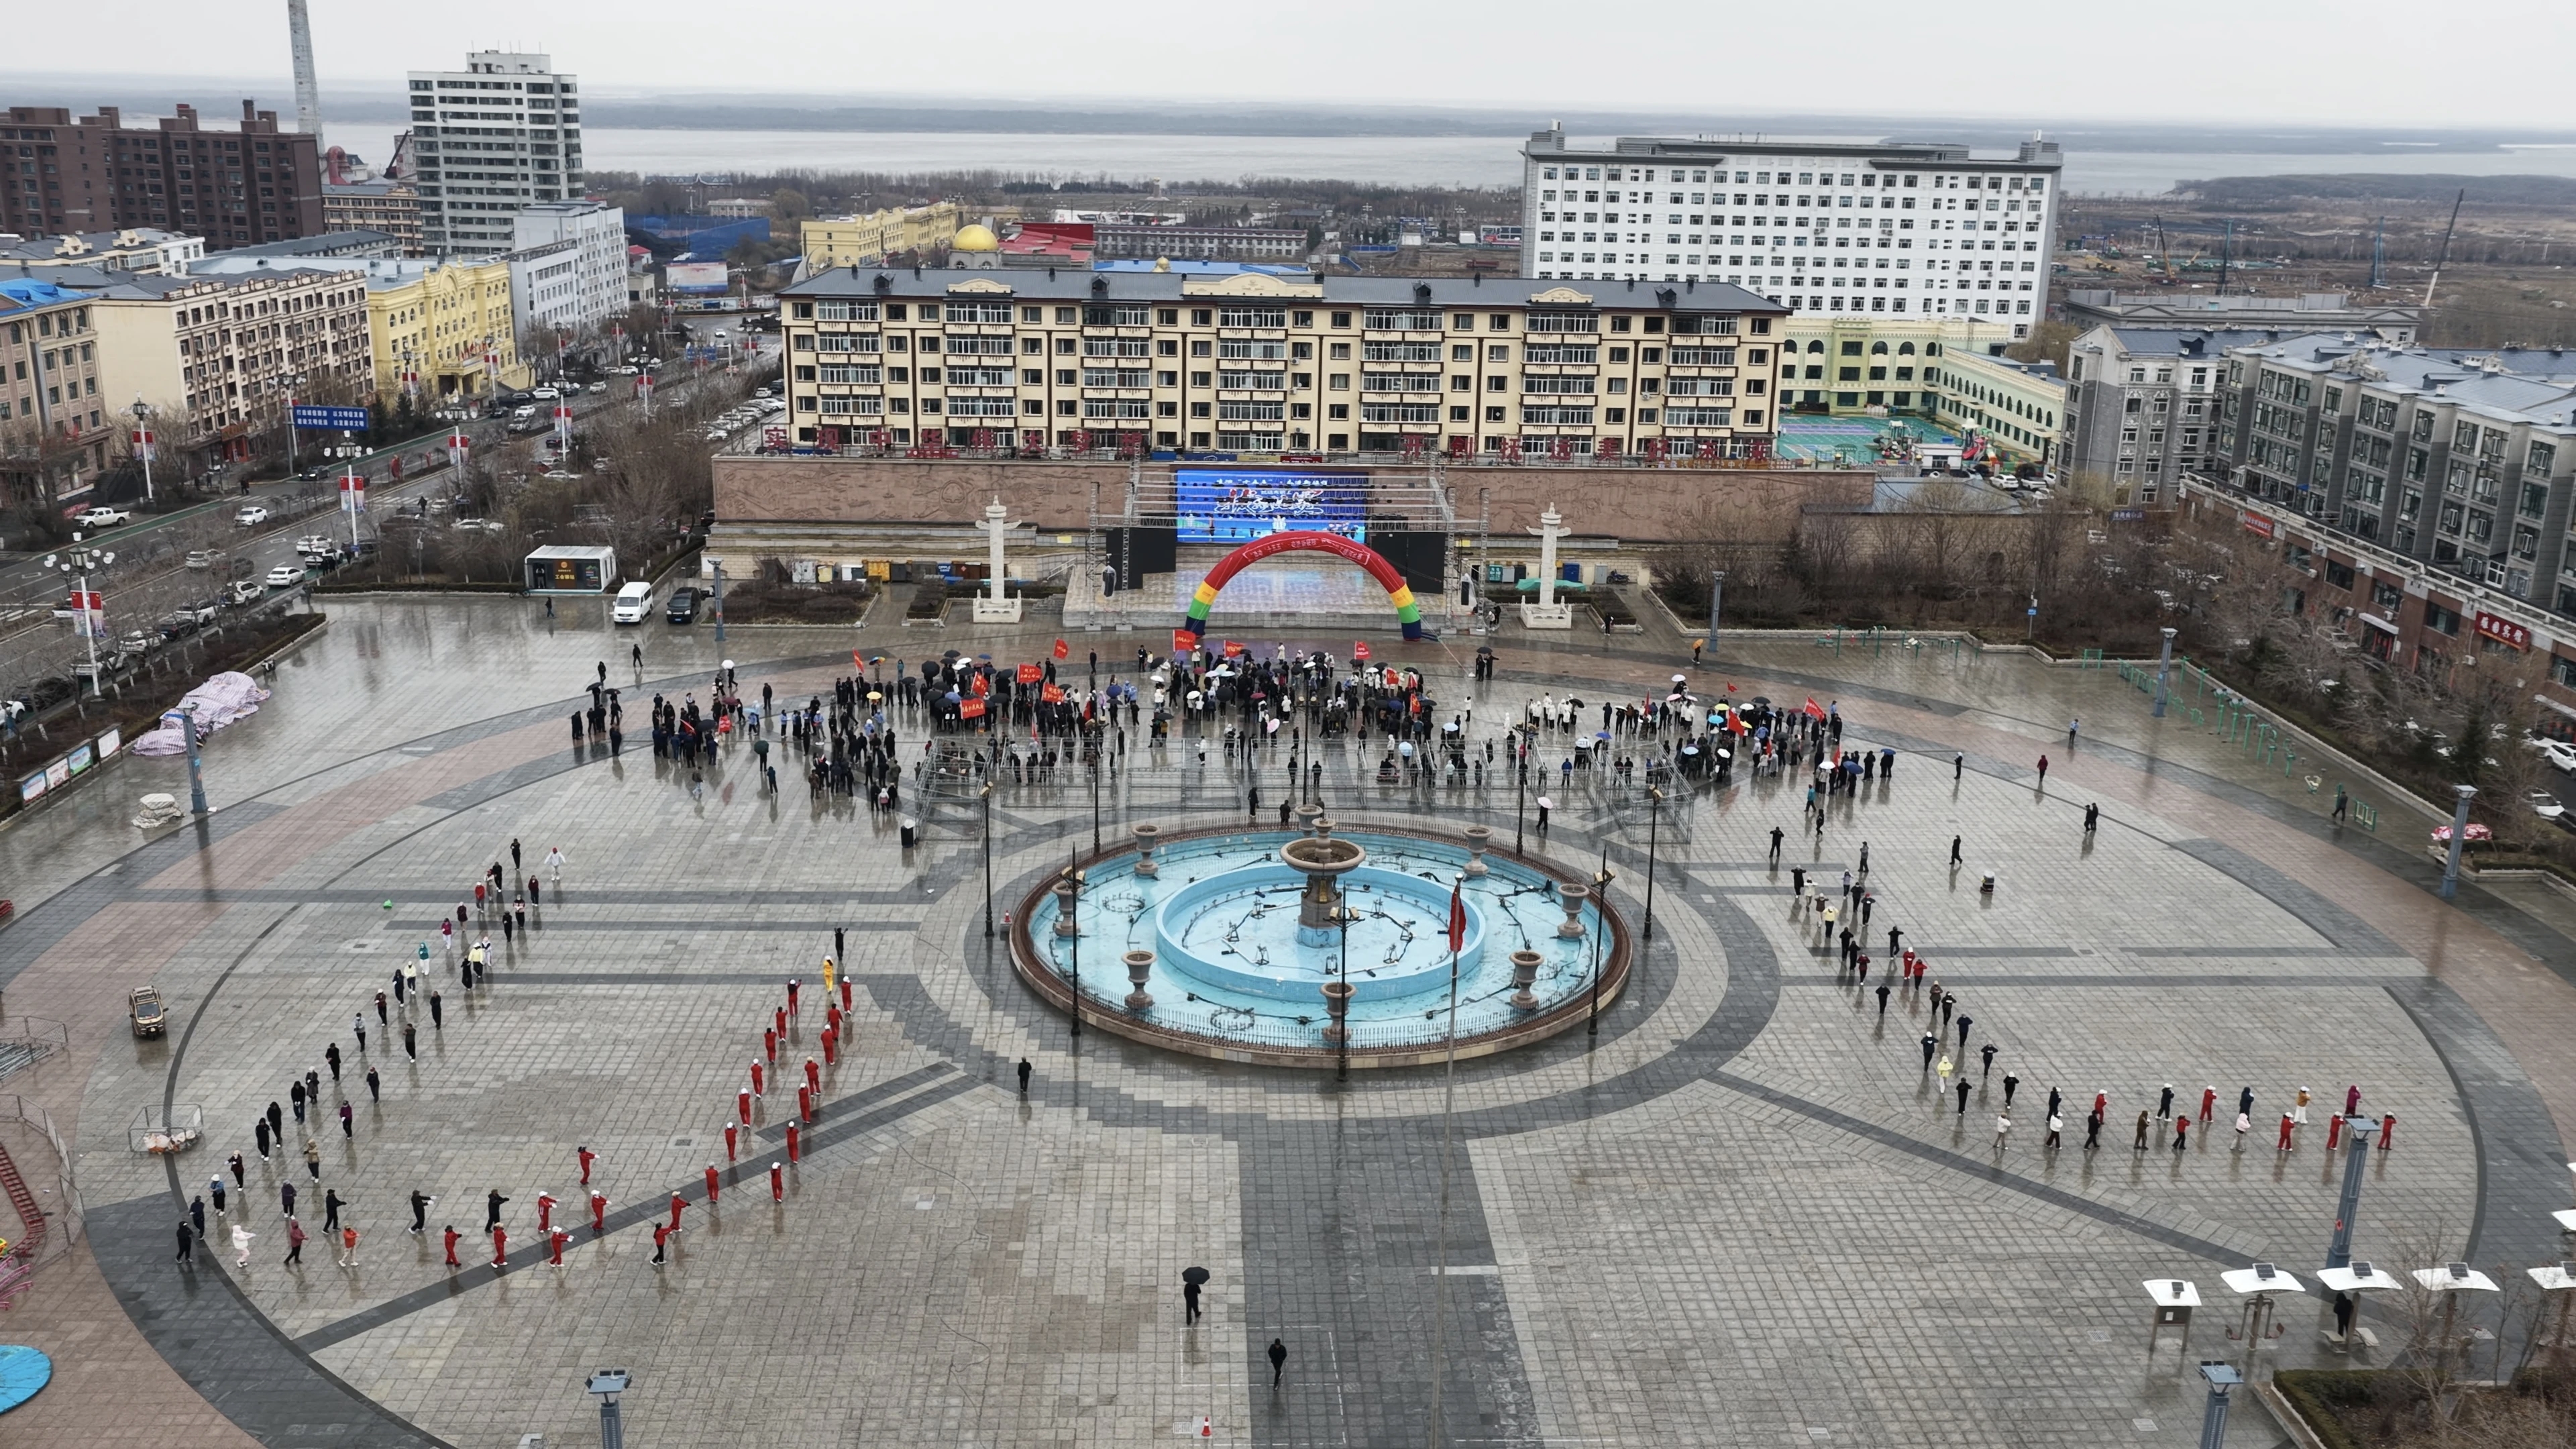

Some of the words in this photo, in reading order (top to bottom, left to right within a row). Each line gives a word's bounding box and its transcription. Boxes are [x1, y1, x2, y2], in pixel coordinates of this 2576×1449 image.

[764, 427, 1143, 455] 实现中华伟大梦想
